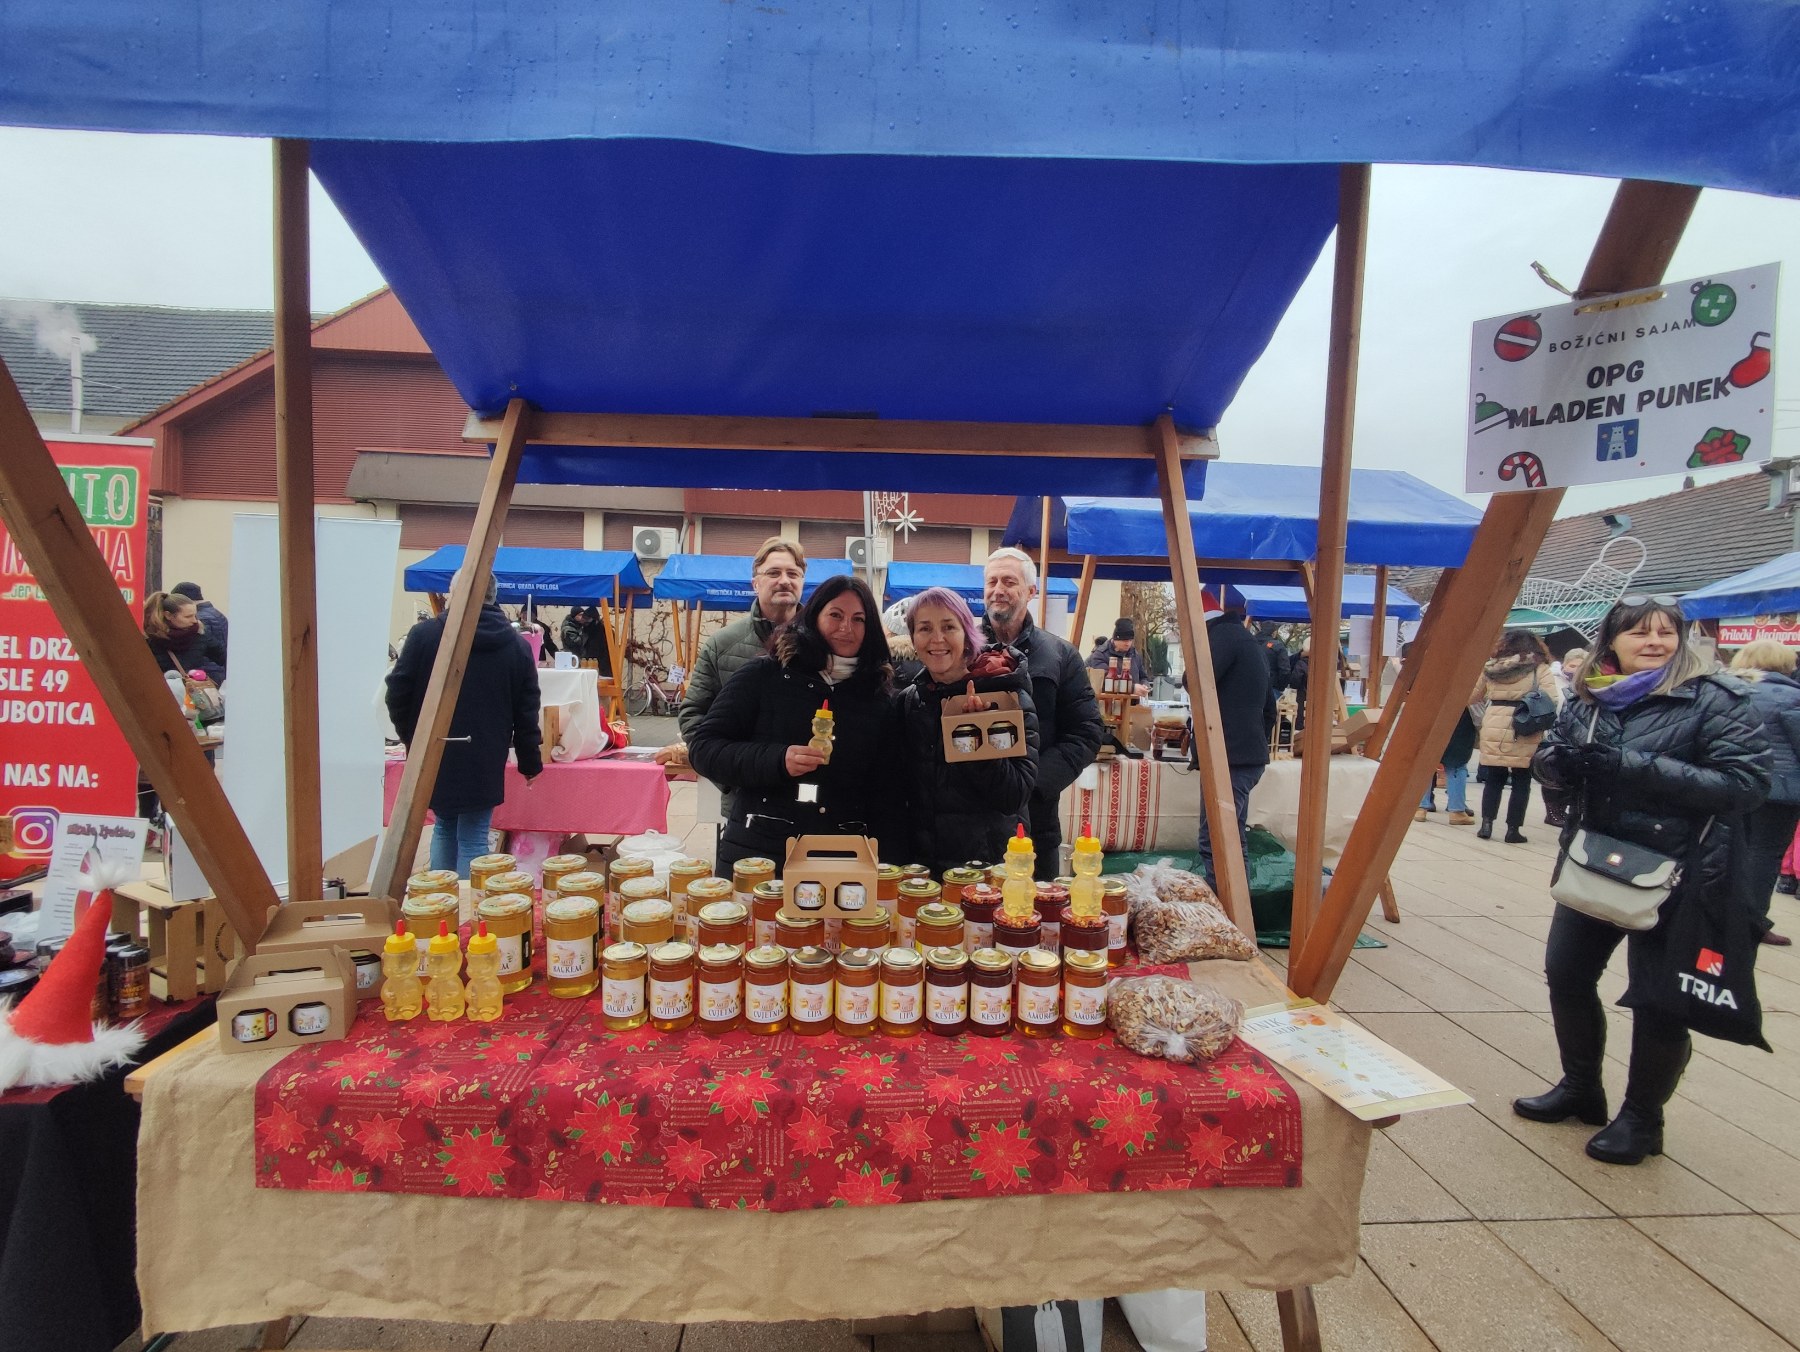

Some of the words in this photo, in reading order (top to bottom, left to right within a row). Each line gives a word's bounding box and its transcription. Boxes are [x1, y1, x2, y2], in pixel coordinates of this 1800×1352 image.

[1549, 332, 1625, 352] BOŽIĆNI
[1635, 318, 1696, 338] SAJAM
[1587, 360, 1644, 389] OPG
[1507, 393, 1627, 429] MLADEN
[1637, 377, 1731, 412] PUNEK
[41, 669, 69, 692] 49
[3, 762, 51, 787] NAS
[57, 764, 99, 788] NA:
[1678, 972, 1738, 1010] TRIA
[807, 1010, 822, 1018] LIPA
[899, 1012, 913, 1020] LIPA
